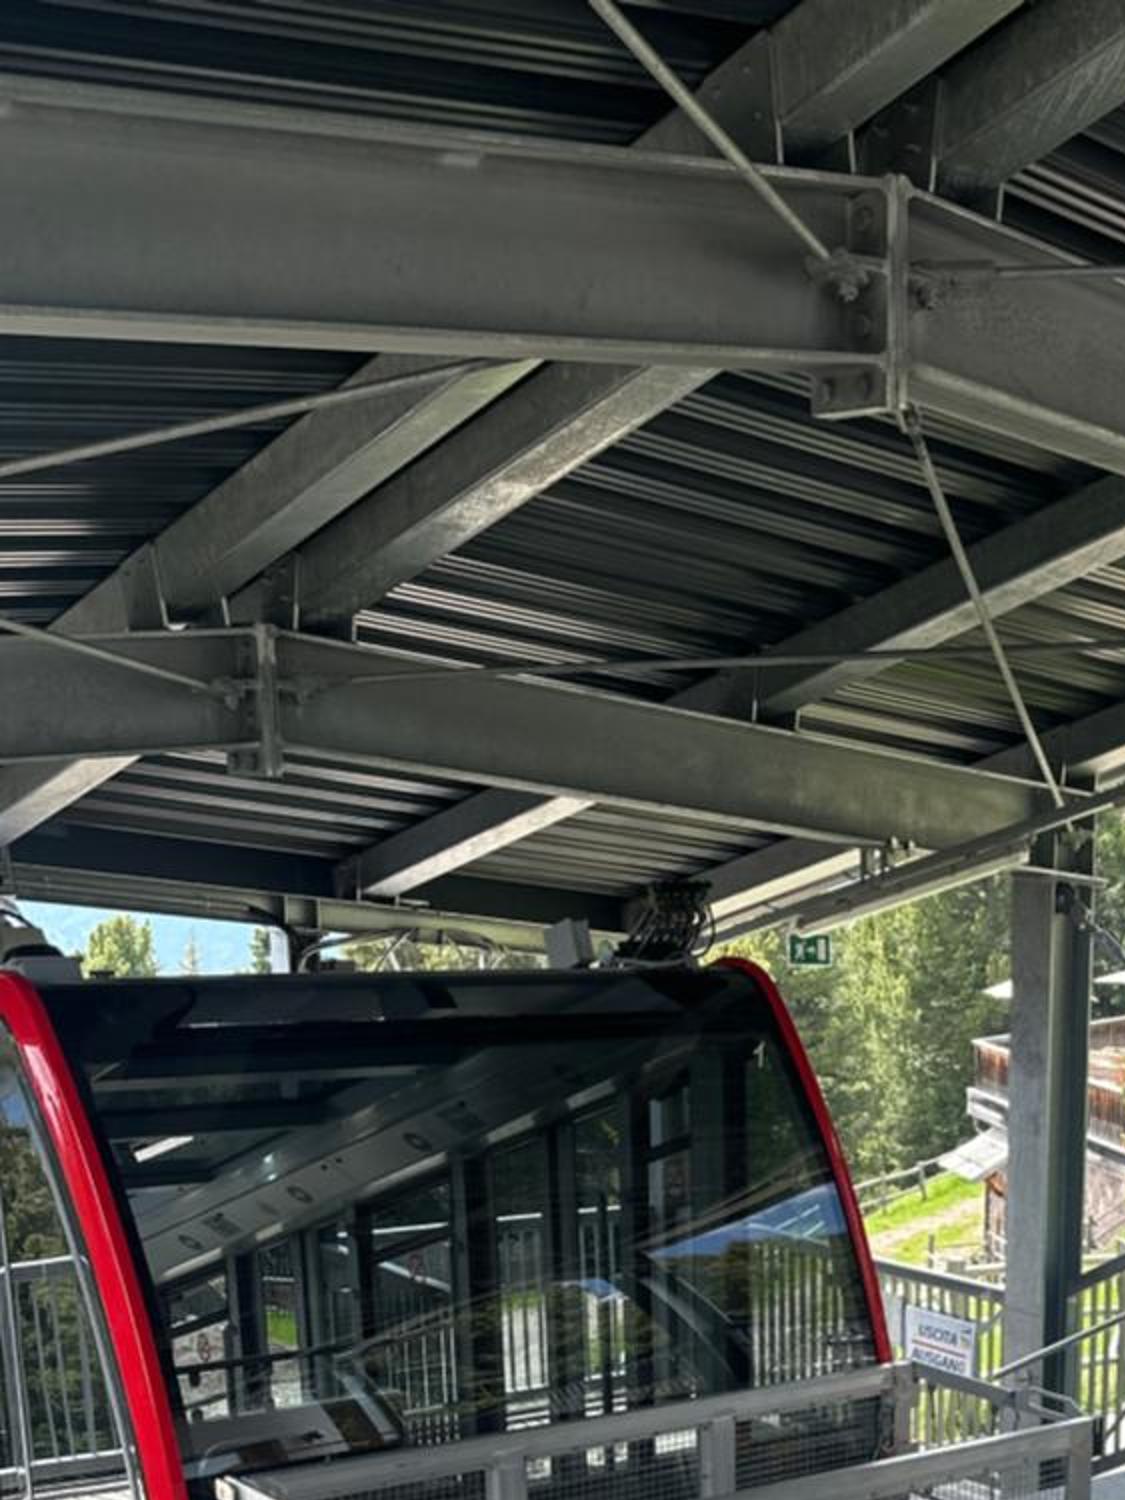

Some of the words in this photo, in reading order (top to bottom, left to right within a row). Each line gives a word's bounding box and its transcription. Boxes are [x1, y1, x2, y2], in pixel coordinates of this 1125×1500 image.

[752, 1040, 766, 1069] 1
[918, 1324, 958, 1347] USCITA
[912, 1347, 967, 1374] AUSGANG
